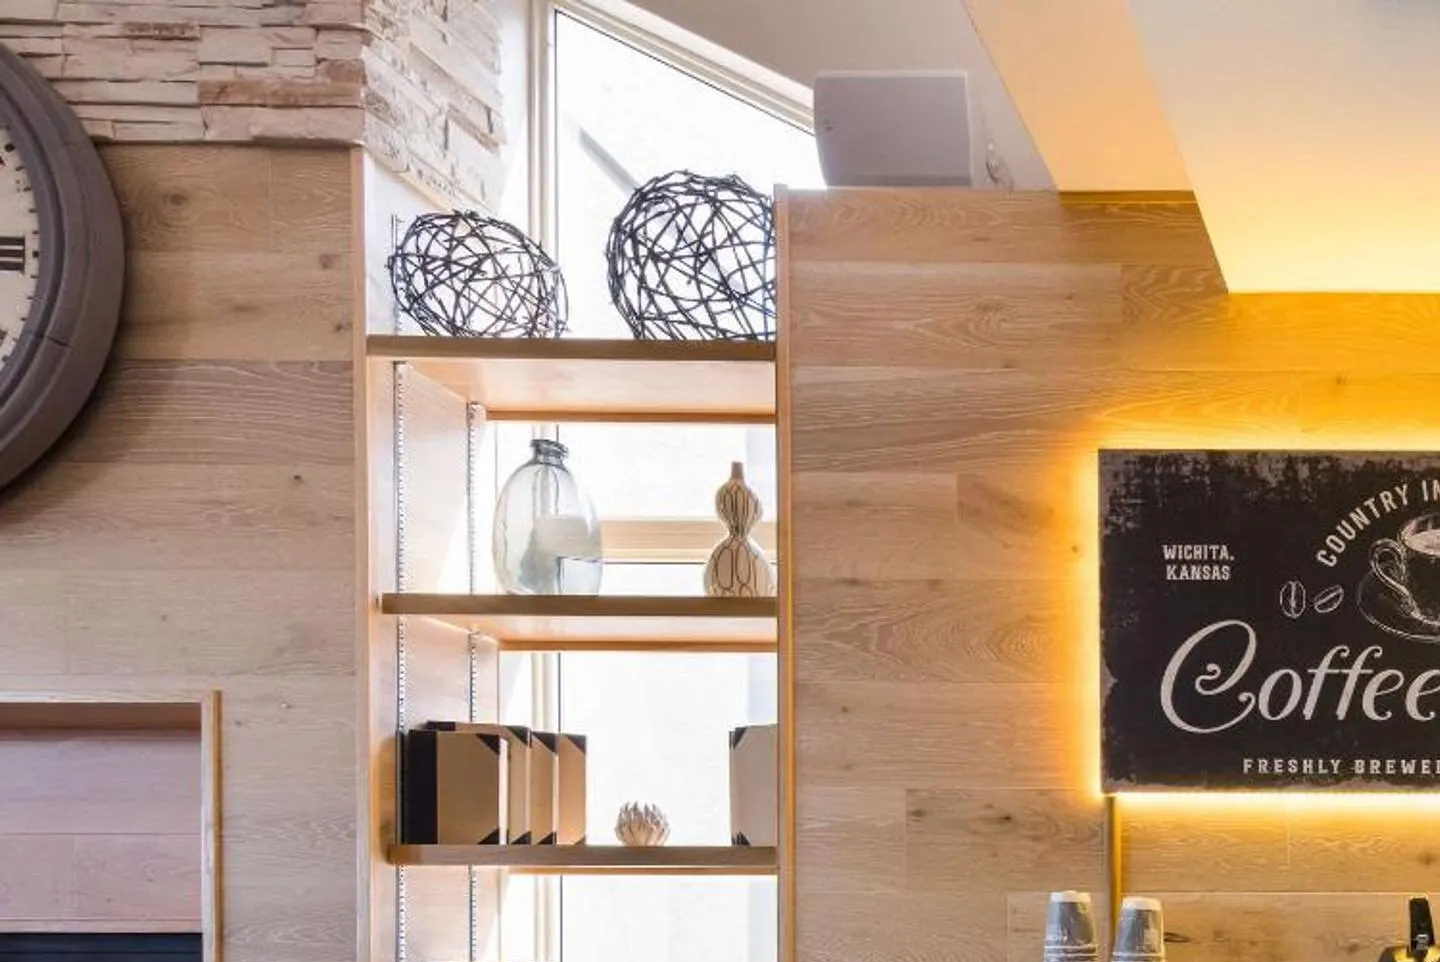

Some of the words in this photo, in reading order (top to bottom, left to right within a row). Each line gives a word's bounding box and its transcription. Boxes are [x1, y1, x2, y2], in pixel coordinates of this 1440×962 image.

[1316, 483, 1409, 567] COUNTRY
[1166, 564, 1231, 581] KANSAS
[1242, 758, 1342, 775] FRESHLY
